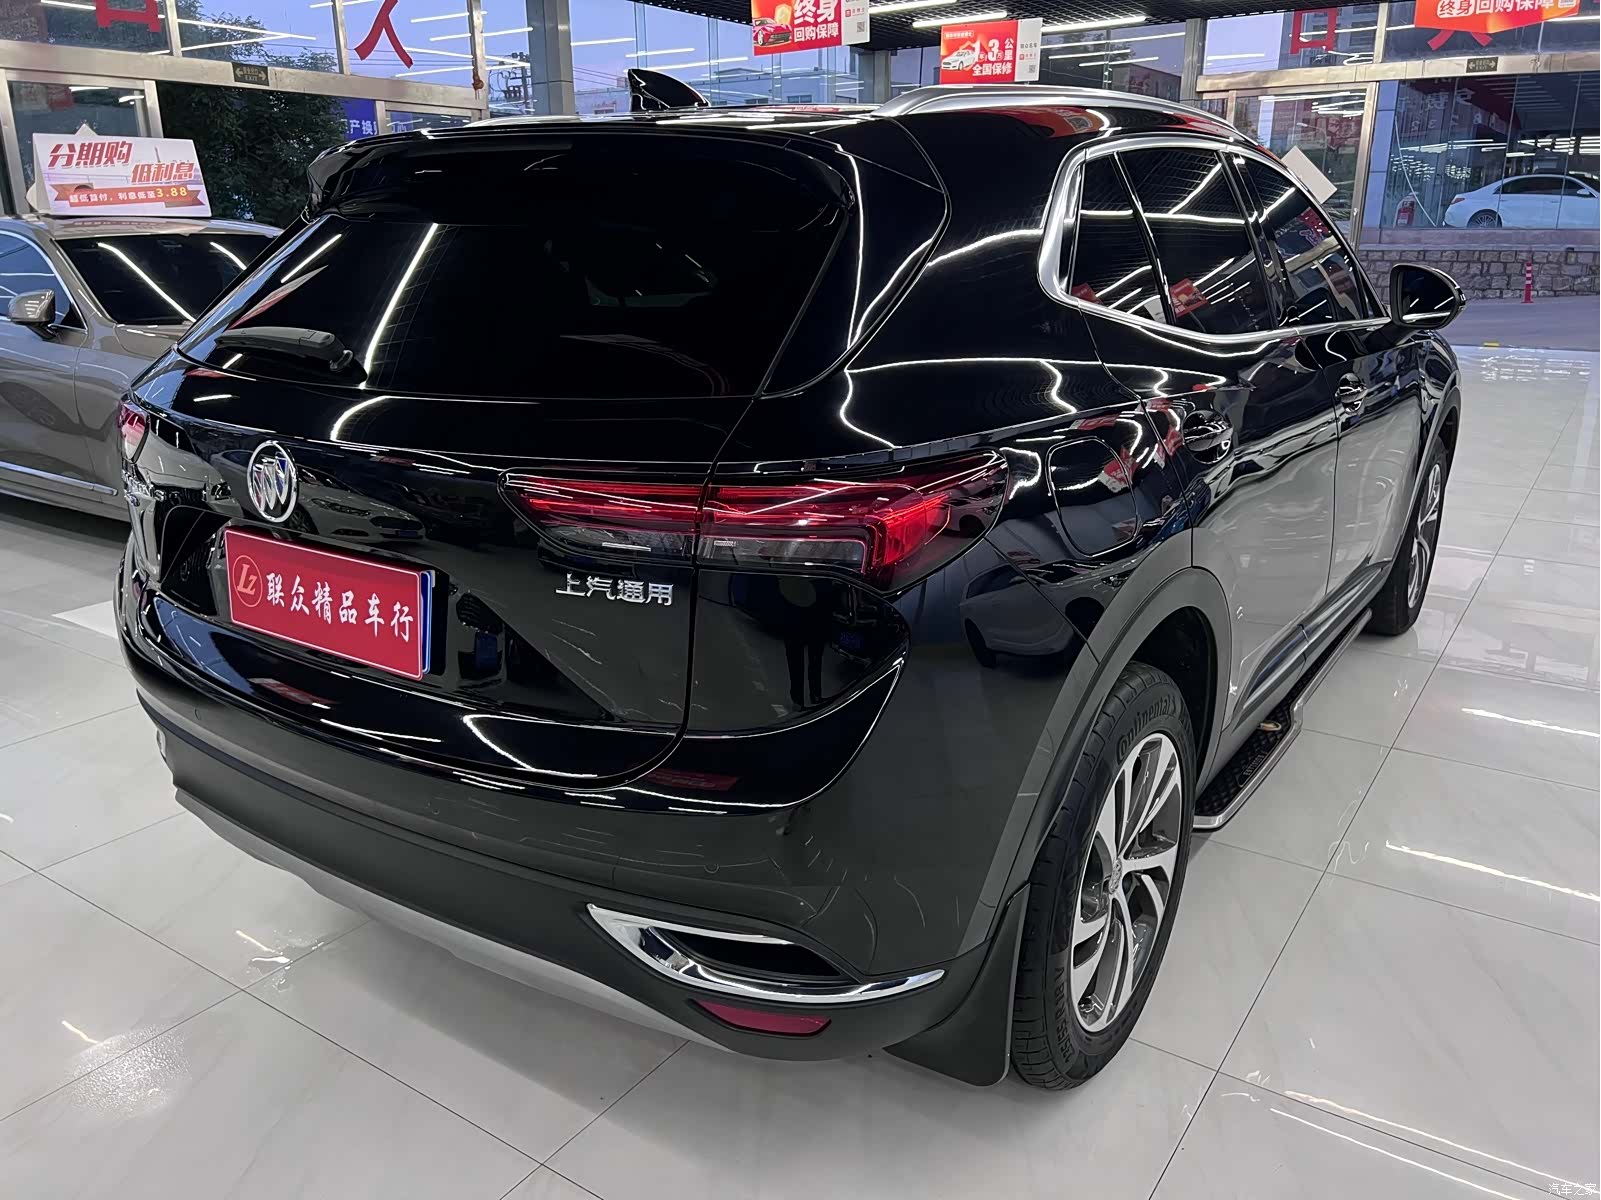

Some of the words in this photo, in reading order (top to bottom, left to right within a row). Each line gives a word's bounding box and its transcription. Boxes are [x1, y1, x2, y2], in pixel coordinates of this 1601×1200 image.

[793, 0, 839, 24] 终身
[793, 22, 839, 42] 回购保障
[972, 62, 1012, 76] 全国保修
[48, 141, 133, 168] 分期购
[131, 162, 195, 184] 低利息
[555, 571, 674, 606] 上汽通用
[266, 572, 414, 643] 联众精品车行
